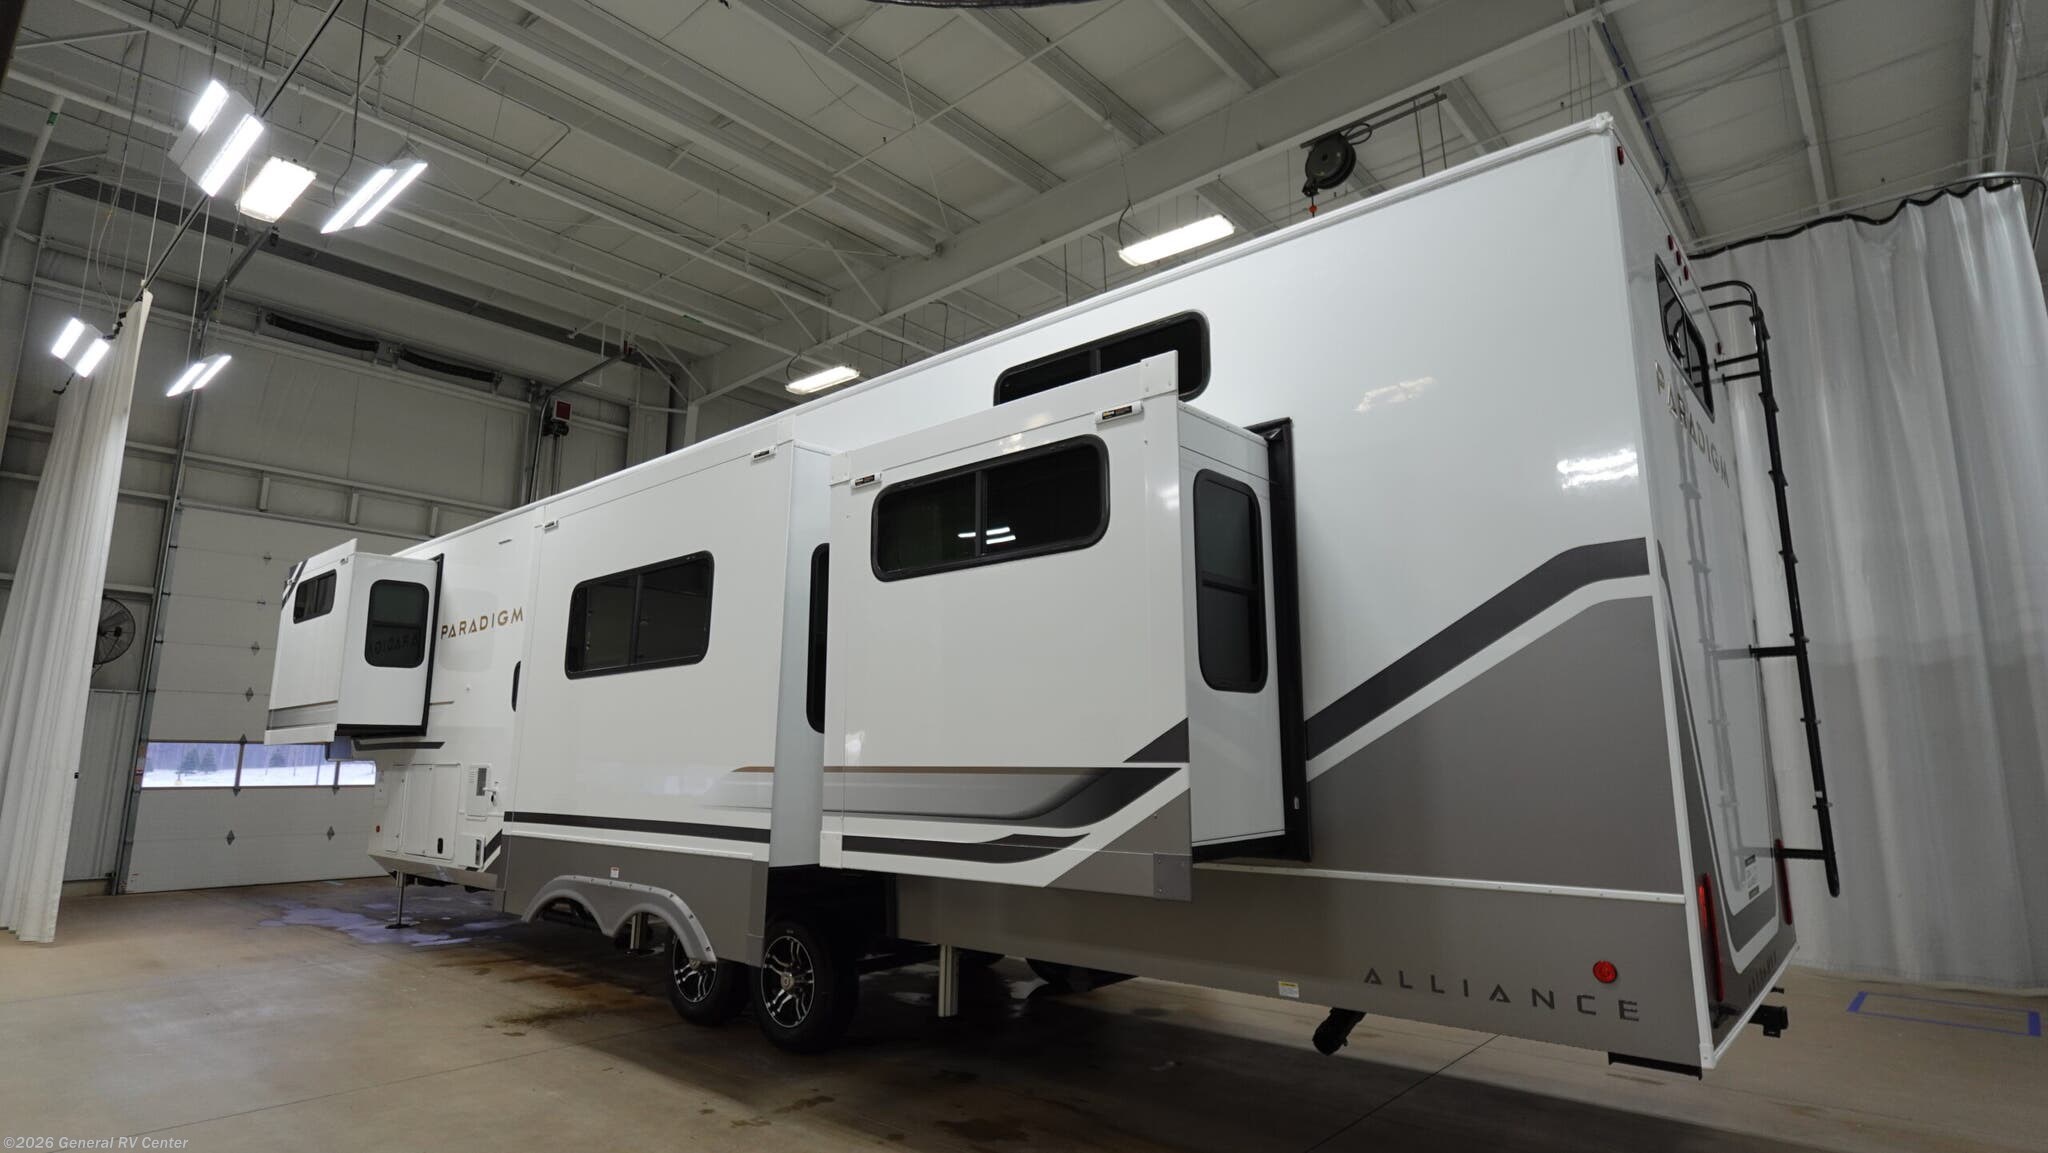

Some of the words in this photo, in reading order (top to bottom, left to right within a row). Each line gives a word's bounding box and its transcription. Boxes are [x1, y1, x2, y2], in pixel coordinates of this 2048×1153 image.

[1655, 360, 1729, 489] PARADIGM
[440, 606, 524, 640] PARADIGM
[1363, 966, 1640, 1022] ALLIANCE
